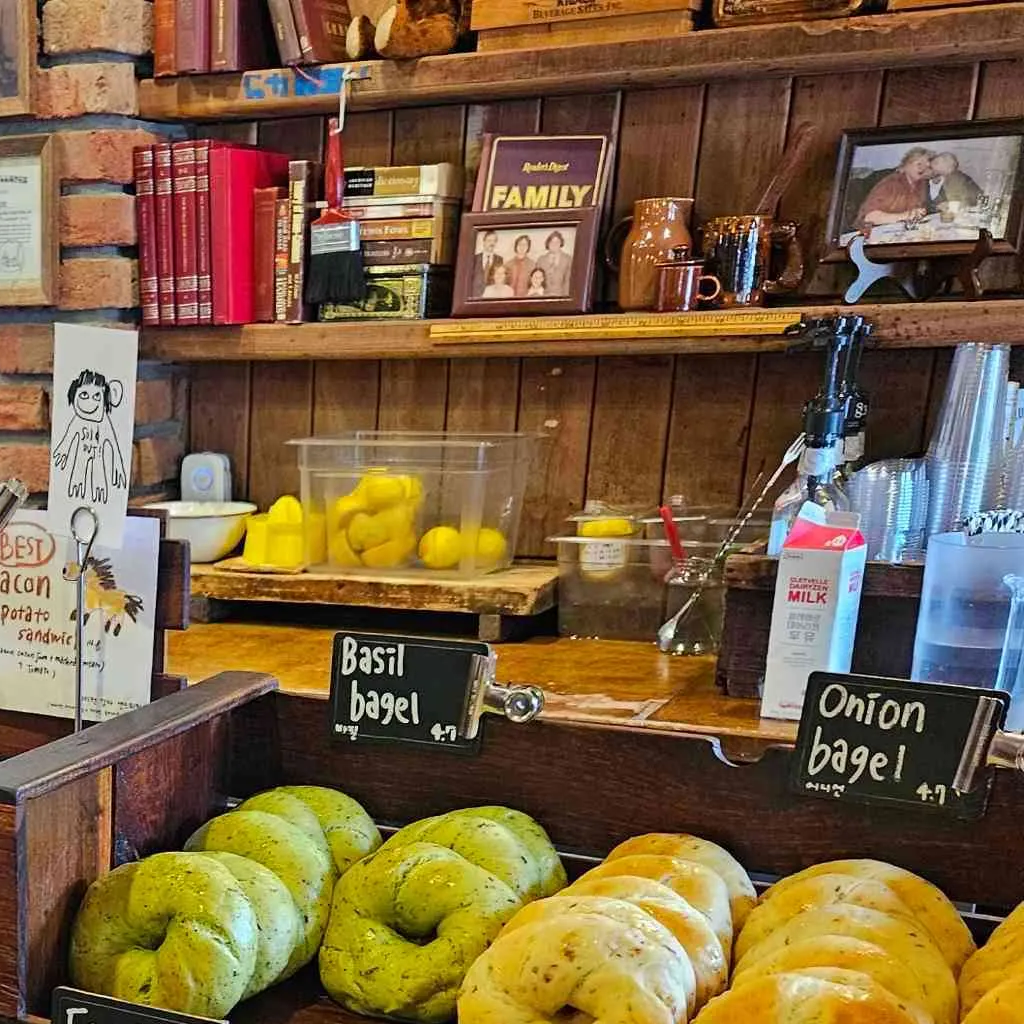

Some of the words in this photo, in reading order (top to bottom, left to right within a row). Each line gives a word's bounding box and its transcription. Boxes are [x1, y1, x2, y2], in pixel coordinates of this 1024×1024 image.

[491, 185, 593, 209] FAMILY
[0, 531, 43, 560] BEST
[787, 590, 827, 604] MILK
[1, 604, 50, 625] potato
[341, 636, 404, 677] Basil
[350, 679, 419, 725] bagel
[818, 683, 926, 733] Onion
[807, 726, 906, 784] bagel
[805, 781, 845, 798] 어니언
